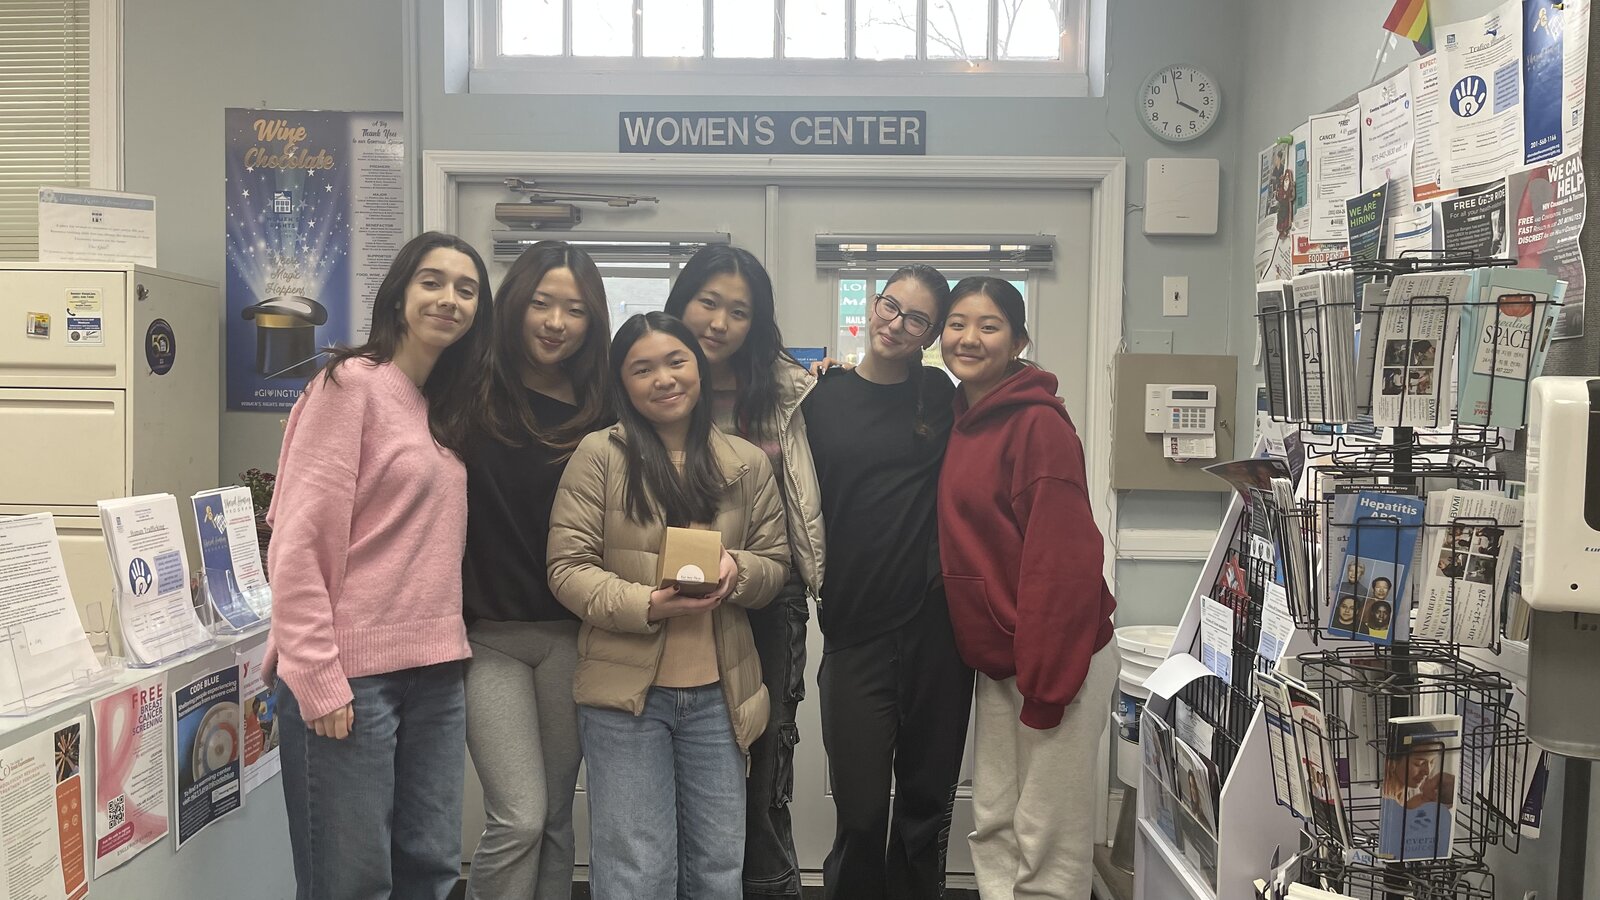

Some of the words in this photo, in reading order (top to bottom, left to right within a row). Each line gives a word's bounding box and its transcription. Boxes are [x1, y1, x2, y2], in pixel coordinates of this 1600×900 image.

[1162, 75, 1166, 84] 11
[1173, 71, 1182, 80] 12
[1190, 73, 1193, 82] 1
[1152, 86, 1160, 94] 10
[1199, 83, 1205, 92] 2
[1147, 99, 1154, 107] 9
[1203, 96, 1209, 105] 3
[1152, 112, 1159, 121] 8
[1199, 110, 1205, 119] 4
[254, 119, 307, 144] Wine
[624, 114, 774, 146] WOMEN'S
[790, 116, 920, 146] CENTER
[1162, 122, 1168, 130] 7
[1175, 125, 1182, 133] 6
[1189, 121, 1196, 129] 5
[244, 147, 334, 170] Chocolate
[1548, 164, 1564, 183] WE
[1566, 156, 1583, 176] CAN
[1557, 173, 1584, 199] HELP
[1349, 207, 1362, 217] WE
[1363, 201, 1377, 211] ARE
[1454, 199, 1476, 210] FREE
[1350, 212, 1375, 227] HIRING
[1518, 216, 1534, 226] FREE
[1518, 226, 1533, 235] FAST
[1518, 233, 1544, 245] DISCREET
[1308, 254, 1324, 262] FOOD
[1396, 281, 1415, 334] 201-32-2478
[1483, 325, 1531, 349] SPACE
[1360, 498, 1417, 515] Hepatitis
[1450, 496, 1460, 518] BVMI
[1467, 589, 1486, 640] 201-342-2478
[190, 682, 203, 695] CODE
[204, 675, 220, 688] BLUE
[132, 683, 163, 710] FREE
[140, 698, 163, 715] BREAST
[139, 706, 163, 724] CANCER
[132, 715, 163, 736] SCREENING
